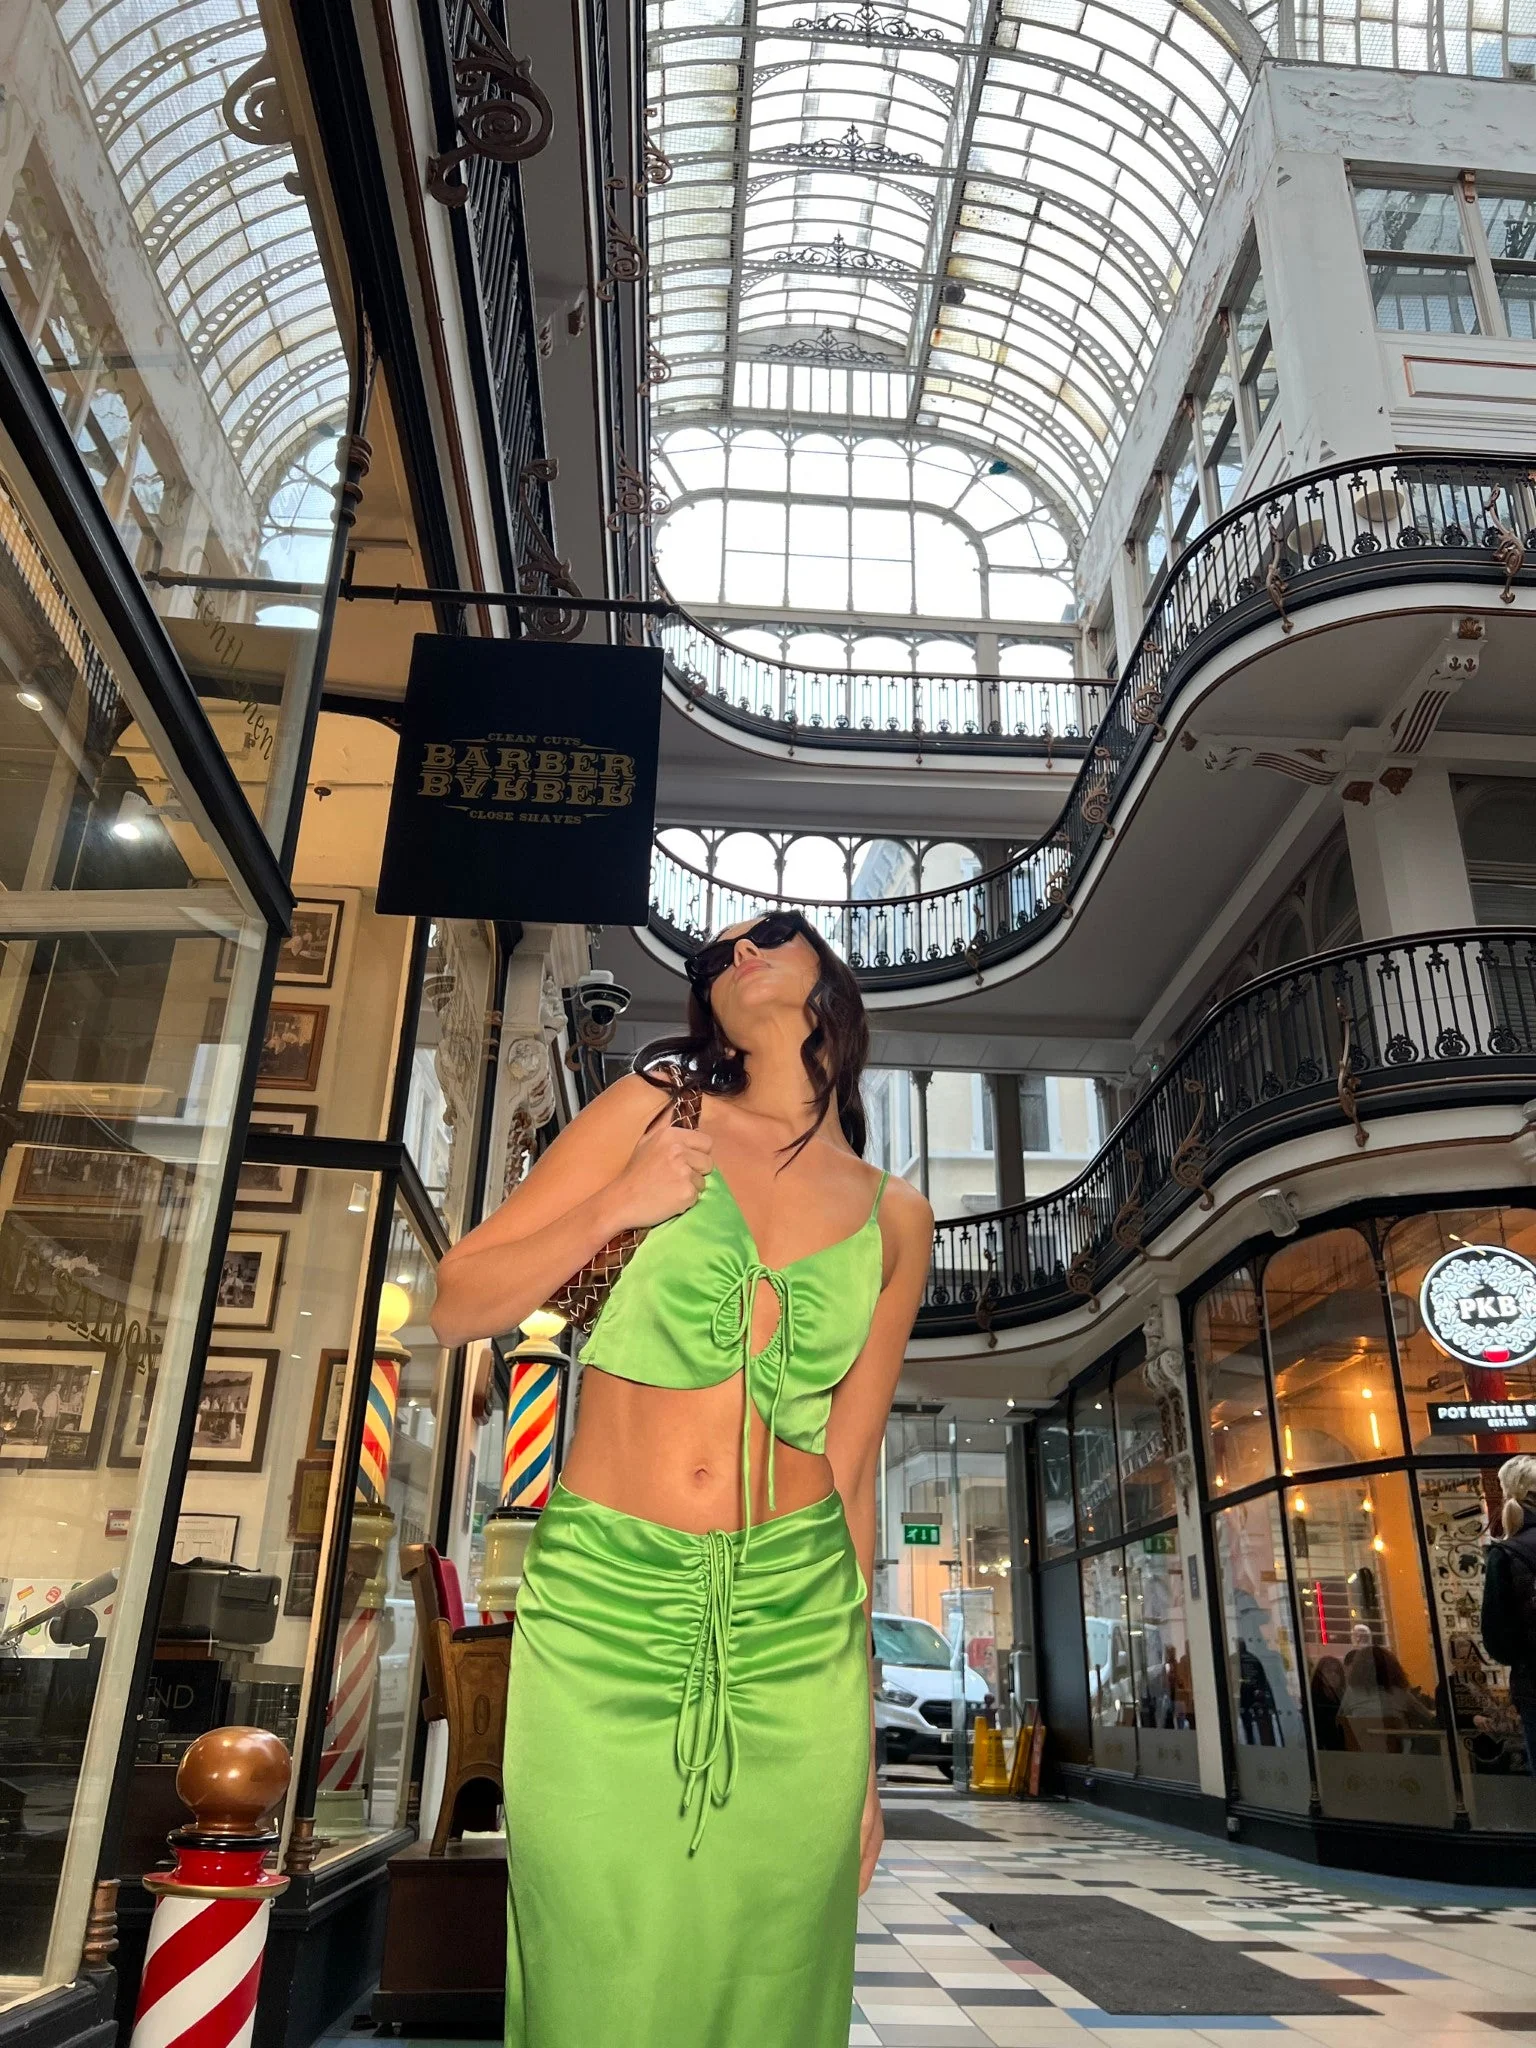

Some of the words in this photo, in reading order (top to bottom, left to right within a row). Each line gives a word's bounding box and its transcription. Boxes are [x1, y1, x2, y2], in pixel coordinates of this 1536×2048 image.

[487, 732, 536, 744] CLEAN
[543, 736, 582, 746] CUTS
[421, 743, 636, 781] BARBER
[469, 810, 514, 821] CLOSE
[519, 813, 582, 824] SHAVES
[1458, 1295, 1518, 1319] PKB
[1438, 1406, 1467, 1419] POT
[1470, 1405, 1524, 1418] KETTLE
[1487, 1418, 1507, 1427] EST.
